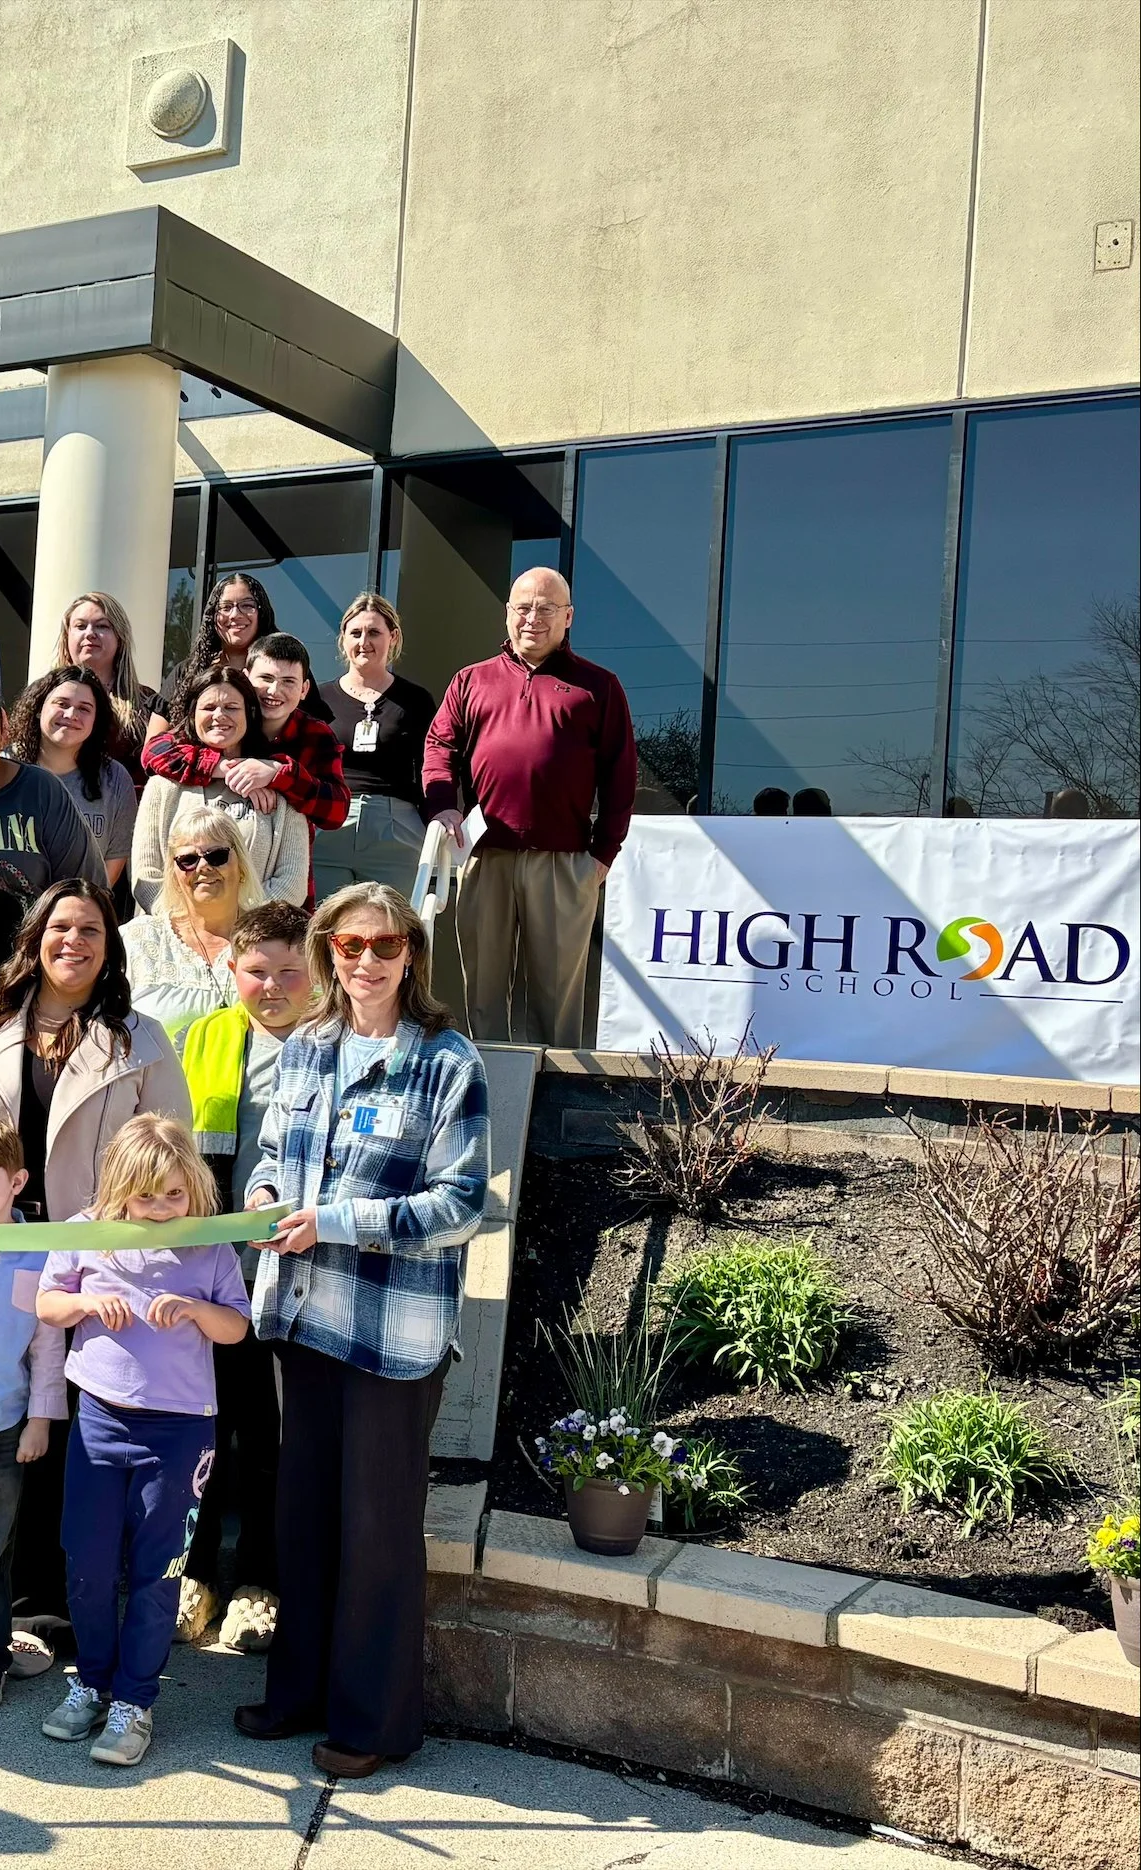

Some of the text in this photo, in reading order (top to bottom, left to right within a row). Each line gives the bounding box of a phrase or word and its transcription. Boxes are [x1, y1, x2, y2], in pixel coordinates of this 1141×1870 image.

[647, 908, 1131, 986] HIGH ROAD
[779, 972, 962, 1001] SCHOOL
